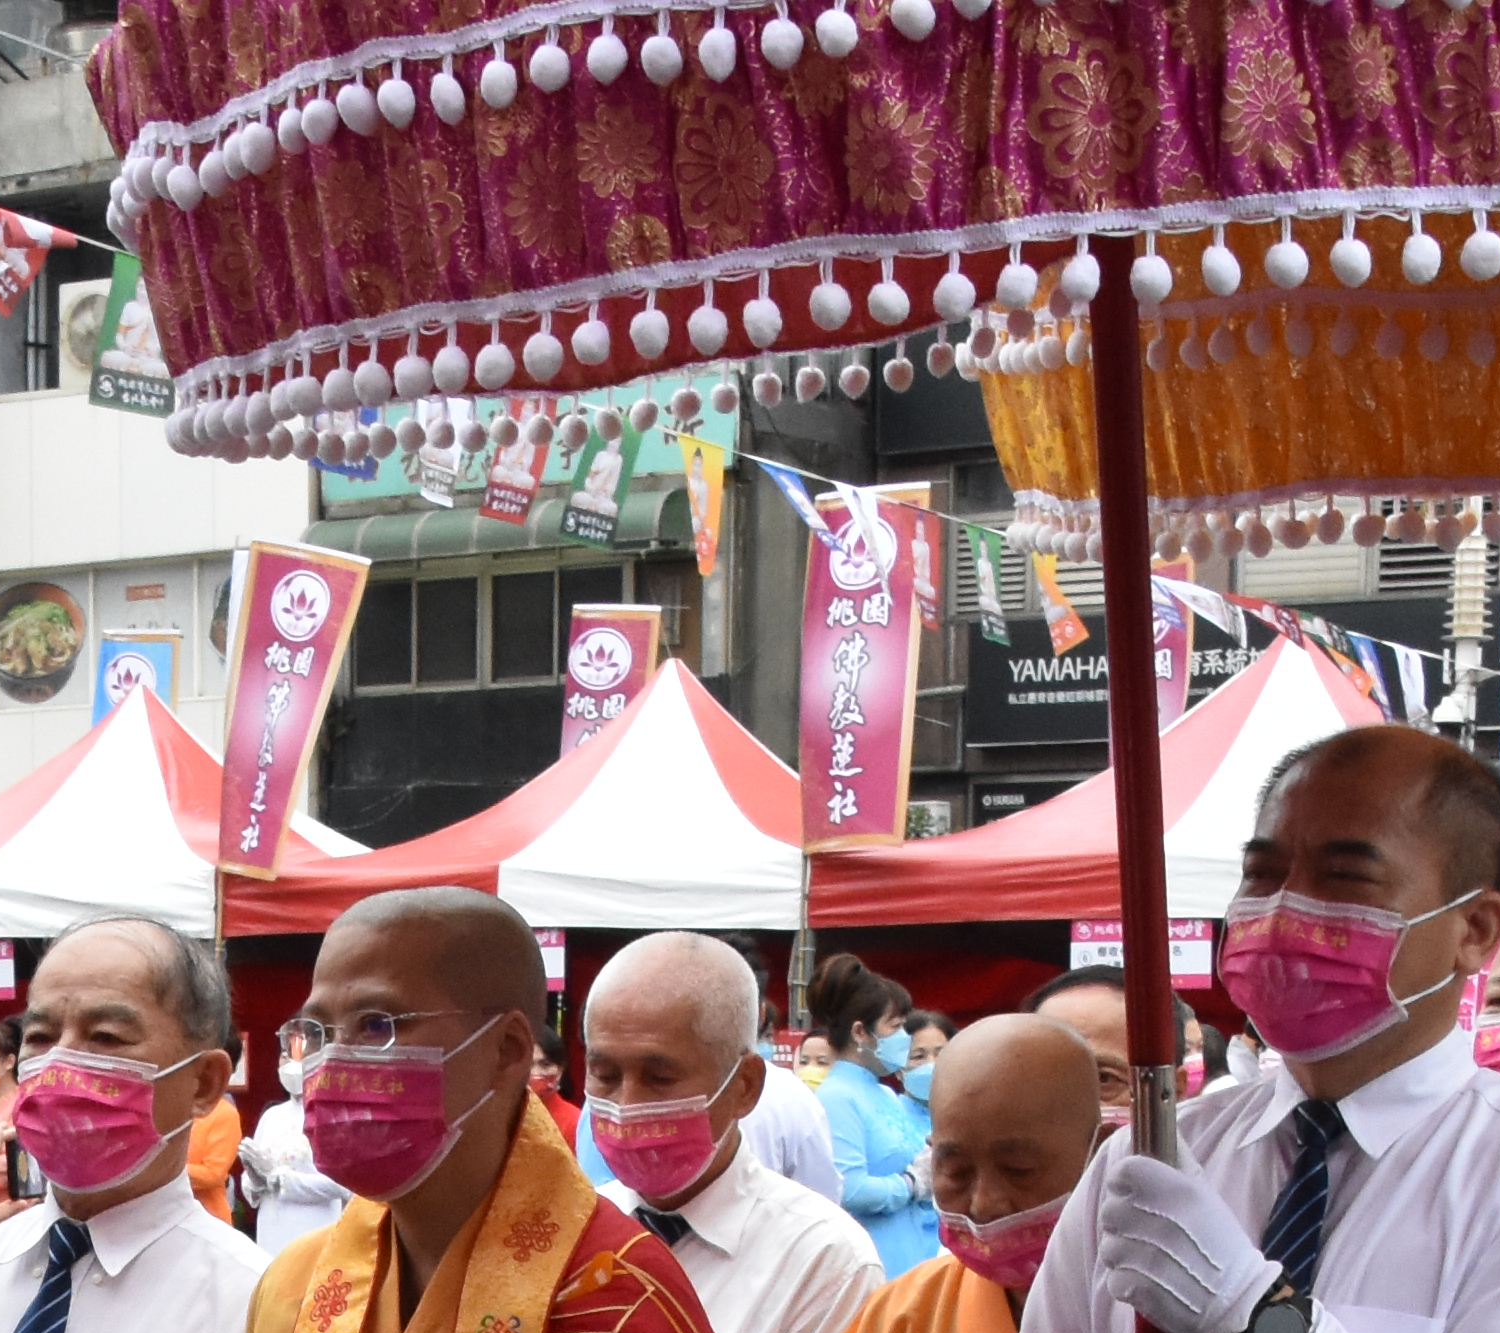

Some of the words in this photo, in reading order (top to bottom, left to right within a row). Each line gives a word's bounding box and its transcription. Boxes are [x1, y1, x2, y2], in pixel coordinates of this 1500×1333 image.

[827, 593, 892, 628] 桃園
[264, 641, 316, 679] 桃園
[1008, 655, 1109, 682] YAMAHA
[567, 692, 626, 719] 桃園
[827, 631, 869, 824] 佛教蓮社
